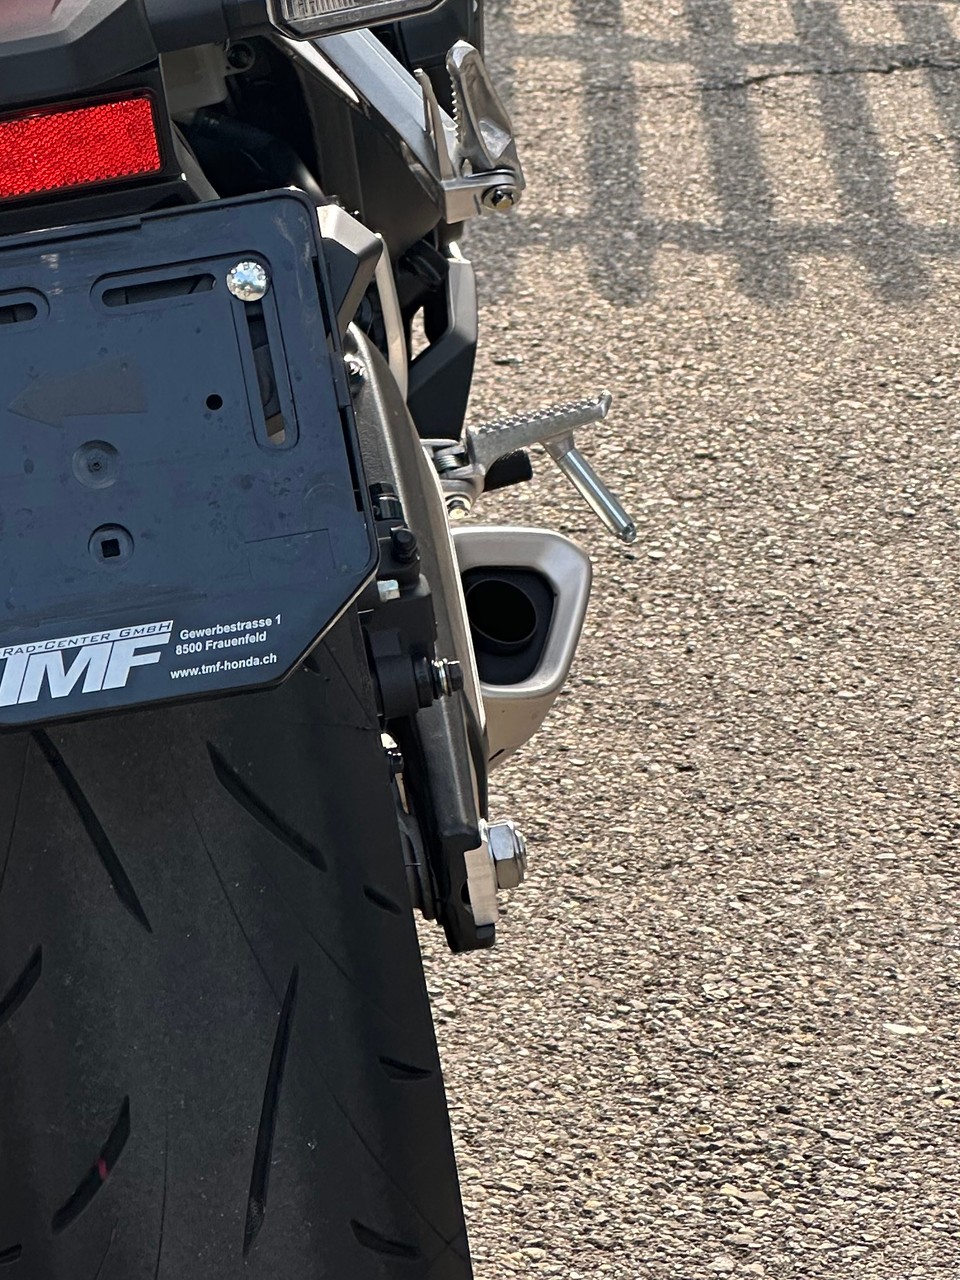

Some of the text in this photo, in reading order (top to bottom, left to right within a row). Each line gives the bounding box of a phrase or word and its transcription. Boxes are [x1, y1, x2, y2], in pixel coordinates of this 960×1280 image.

[179, 614, 281, 640] Gewerbestrasse 1
[175, 631, 267, 656] 8500 Frauenfeld
[170, 652, 278, 680] www.tmf-honda.ch
